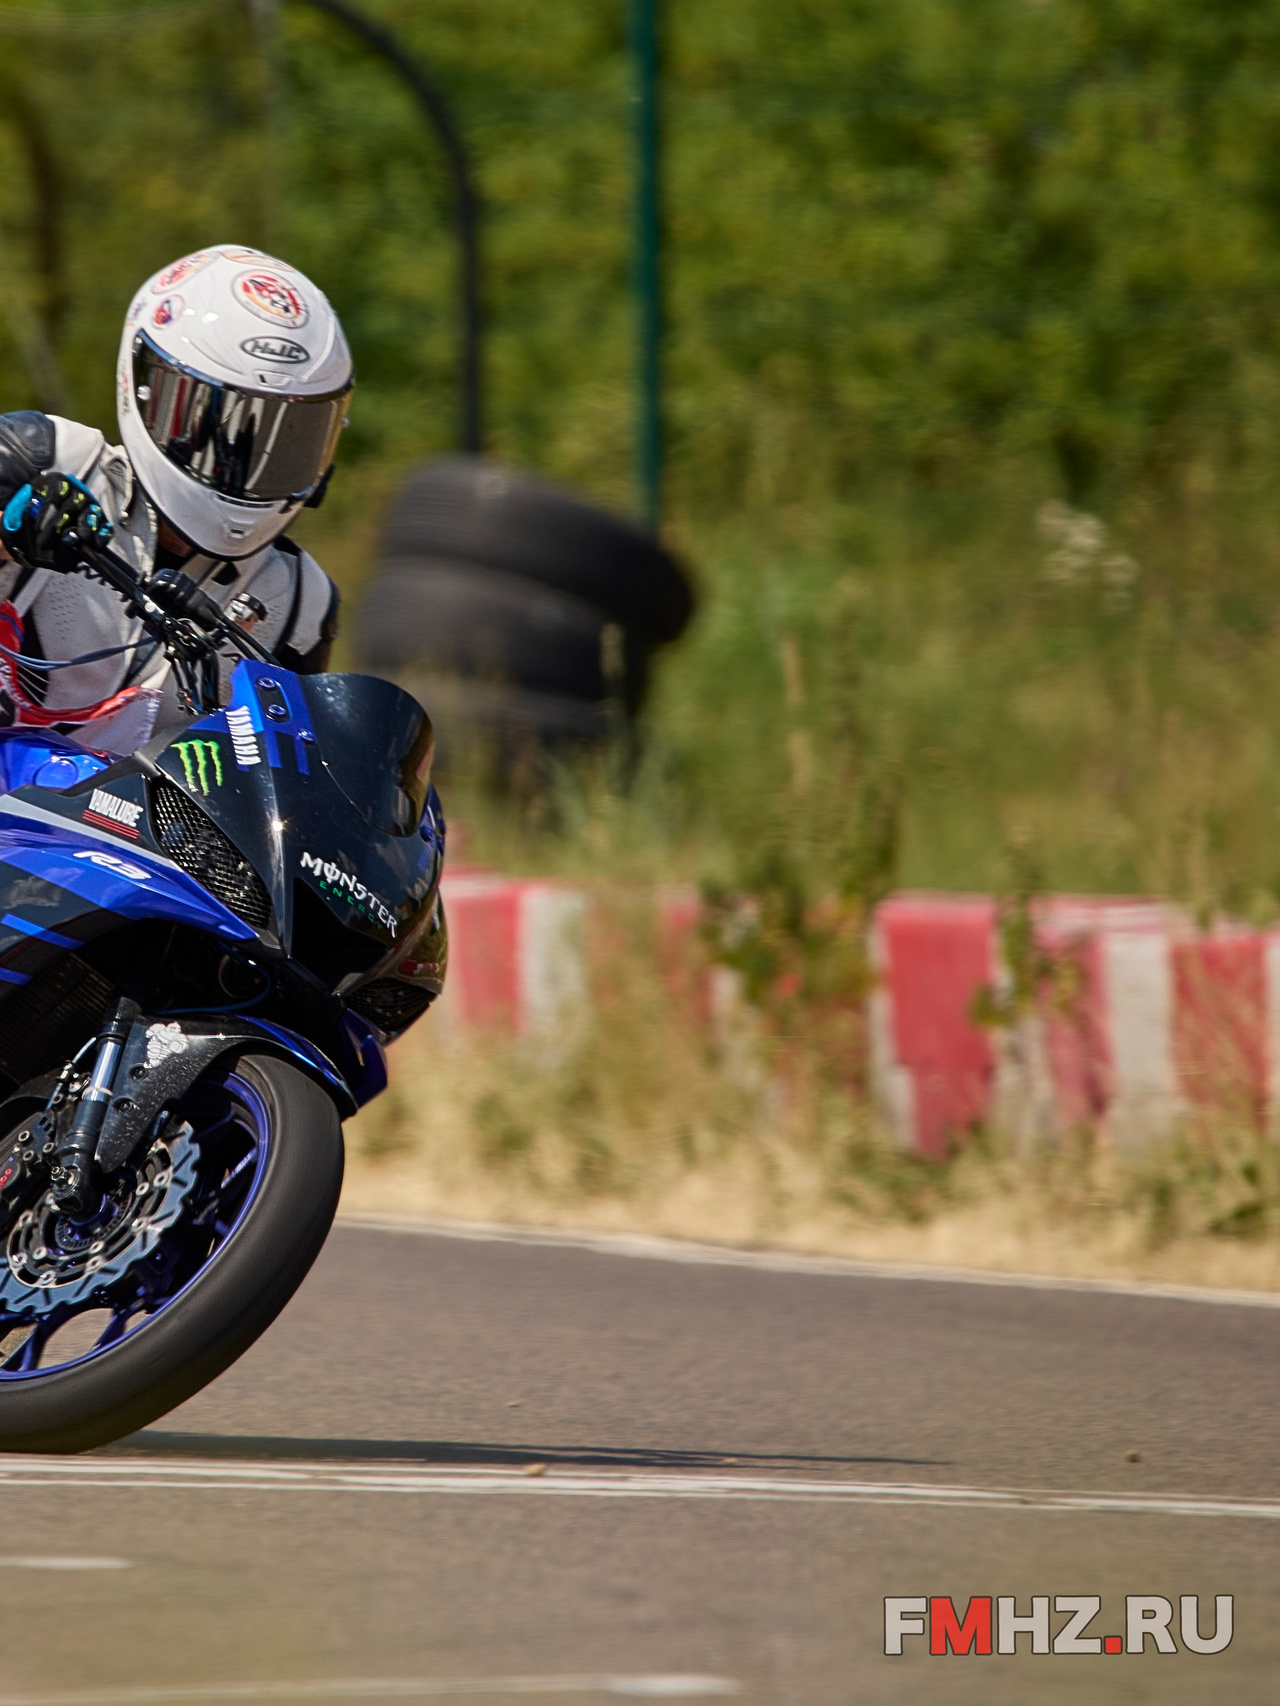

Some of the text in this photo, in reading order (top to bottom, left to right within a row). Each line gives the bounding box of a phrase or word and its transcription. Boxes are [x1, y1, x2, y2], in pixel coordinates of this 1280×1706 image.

[225, 705, 262, 765] YAMAHA
[88, 788, 144, 828] YAMALUBE
[73, 850, 152, 880] R3
[300, 851, 398, 939] MONSTER
[319, 880, 383, 929] ENERGY
